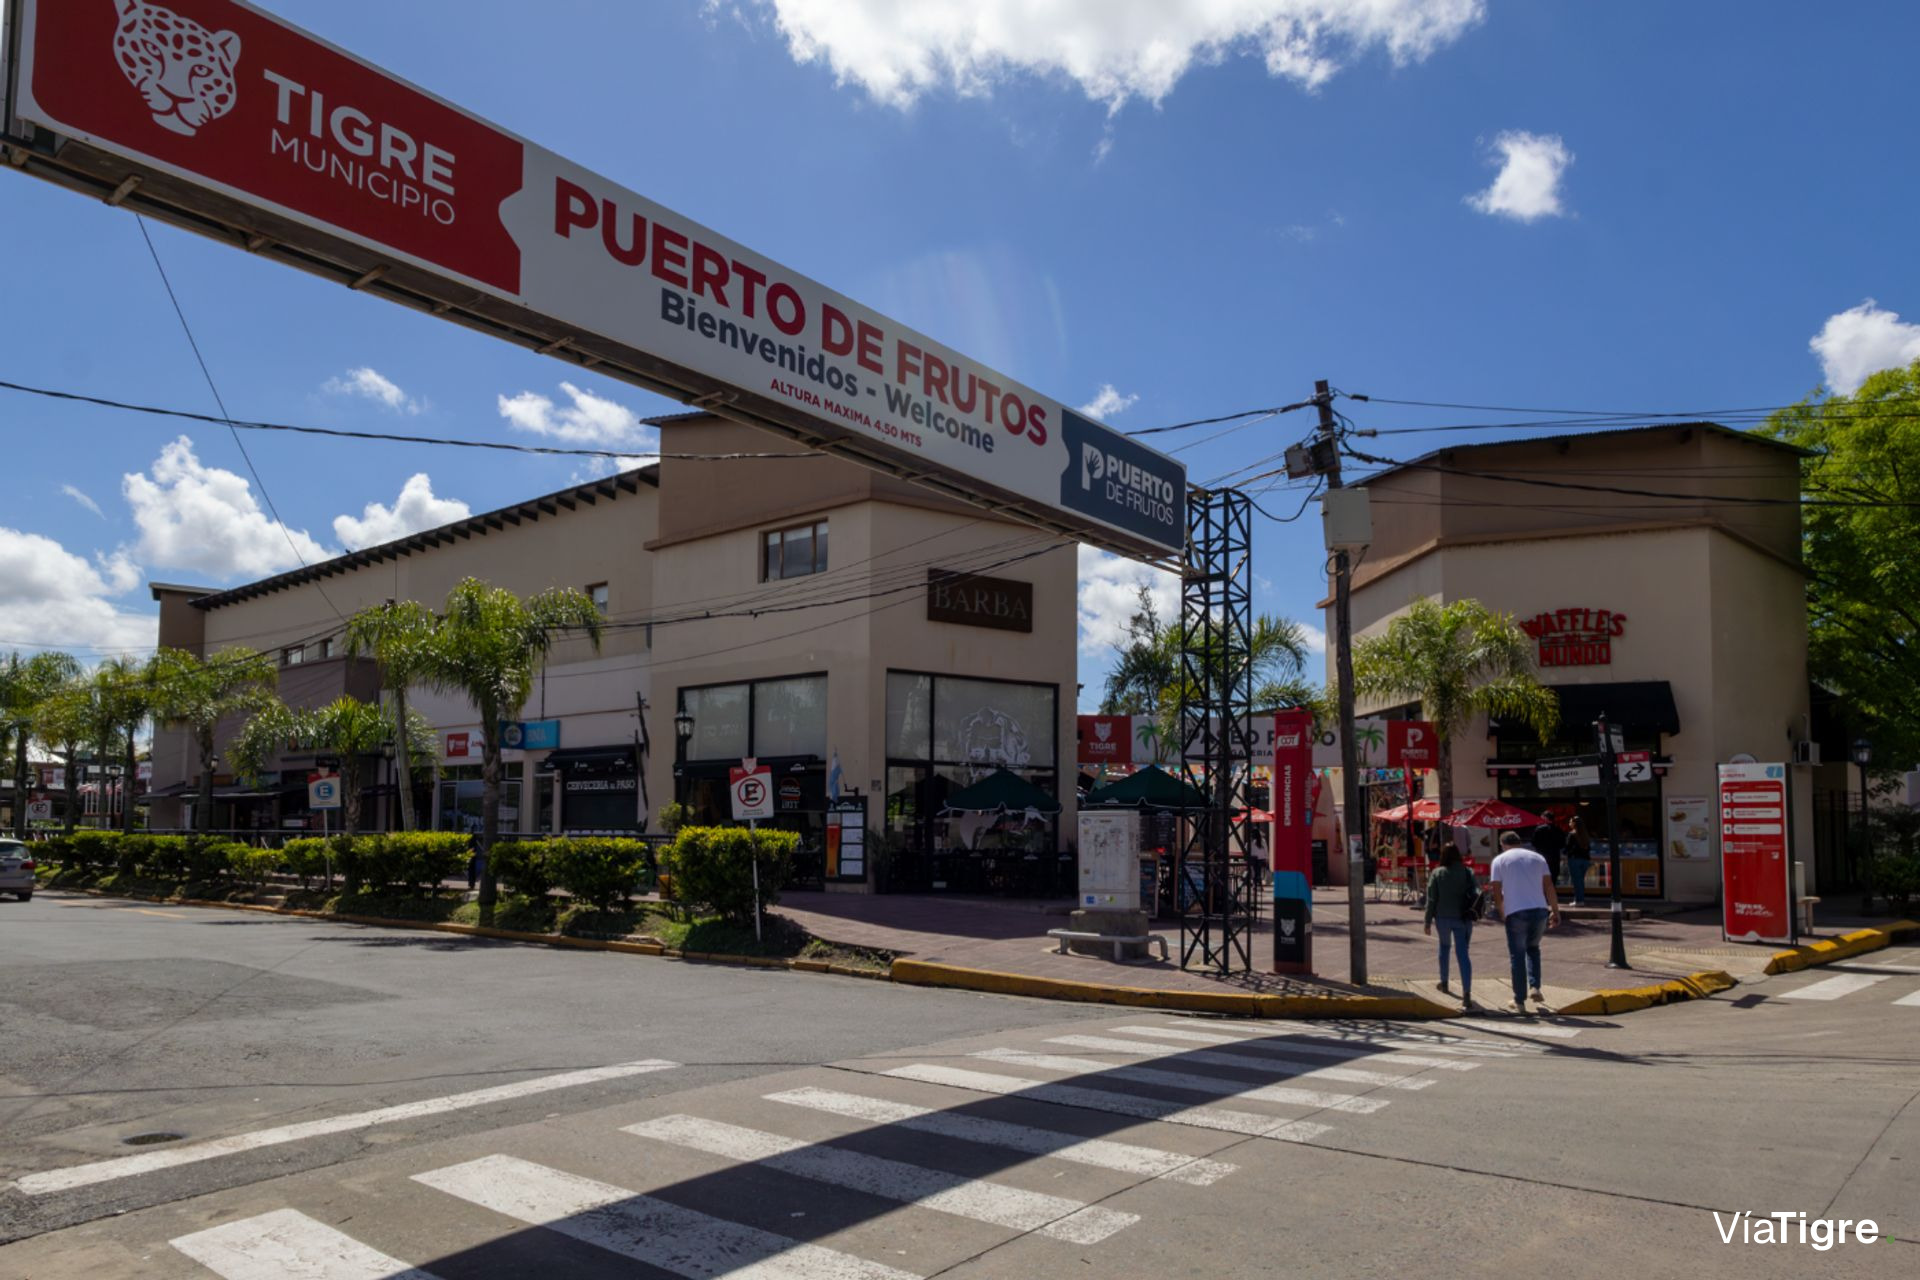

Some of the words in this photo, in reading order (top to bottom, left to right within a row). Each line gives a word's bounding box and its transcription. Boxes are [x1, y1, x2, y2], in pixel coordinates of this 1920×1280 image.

[264, 69, 456, 196] TIGRE
[271, 129, 456, 225] MUNICIPIO
[555, 175, 806, 336] PUERTO
[822, 302, 884, 375] DE
[897, 339, 1048, 447] FRUTOS
[661, 287, 858, 397] Bienvenidos
[884, 383, 995, 453] Welcome
[770, 378, 821, 408] ALTURA
[824, 398, 871, 428] MAXIMA
[874, 420, 898, 438] 4.50
[901, 430, 922, 448] MTS
[1106, 454, 1174, 504] PUERTO
[1106, 480, 1124, 505] DE
[1126, 490, 1174, 525] FRUTOS
[934, 583, 1027, 619] BARBA
[1519, 607, 1627, 640] WAFFLES
[1539, 642, 1611, 667] MUNDO
[1089, 742, 1118, 750] TIGRE
[319, 785, 329, 797] E
[1283, 765, 1292, 826] EMERGENCIAS
